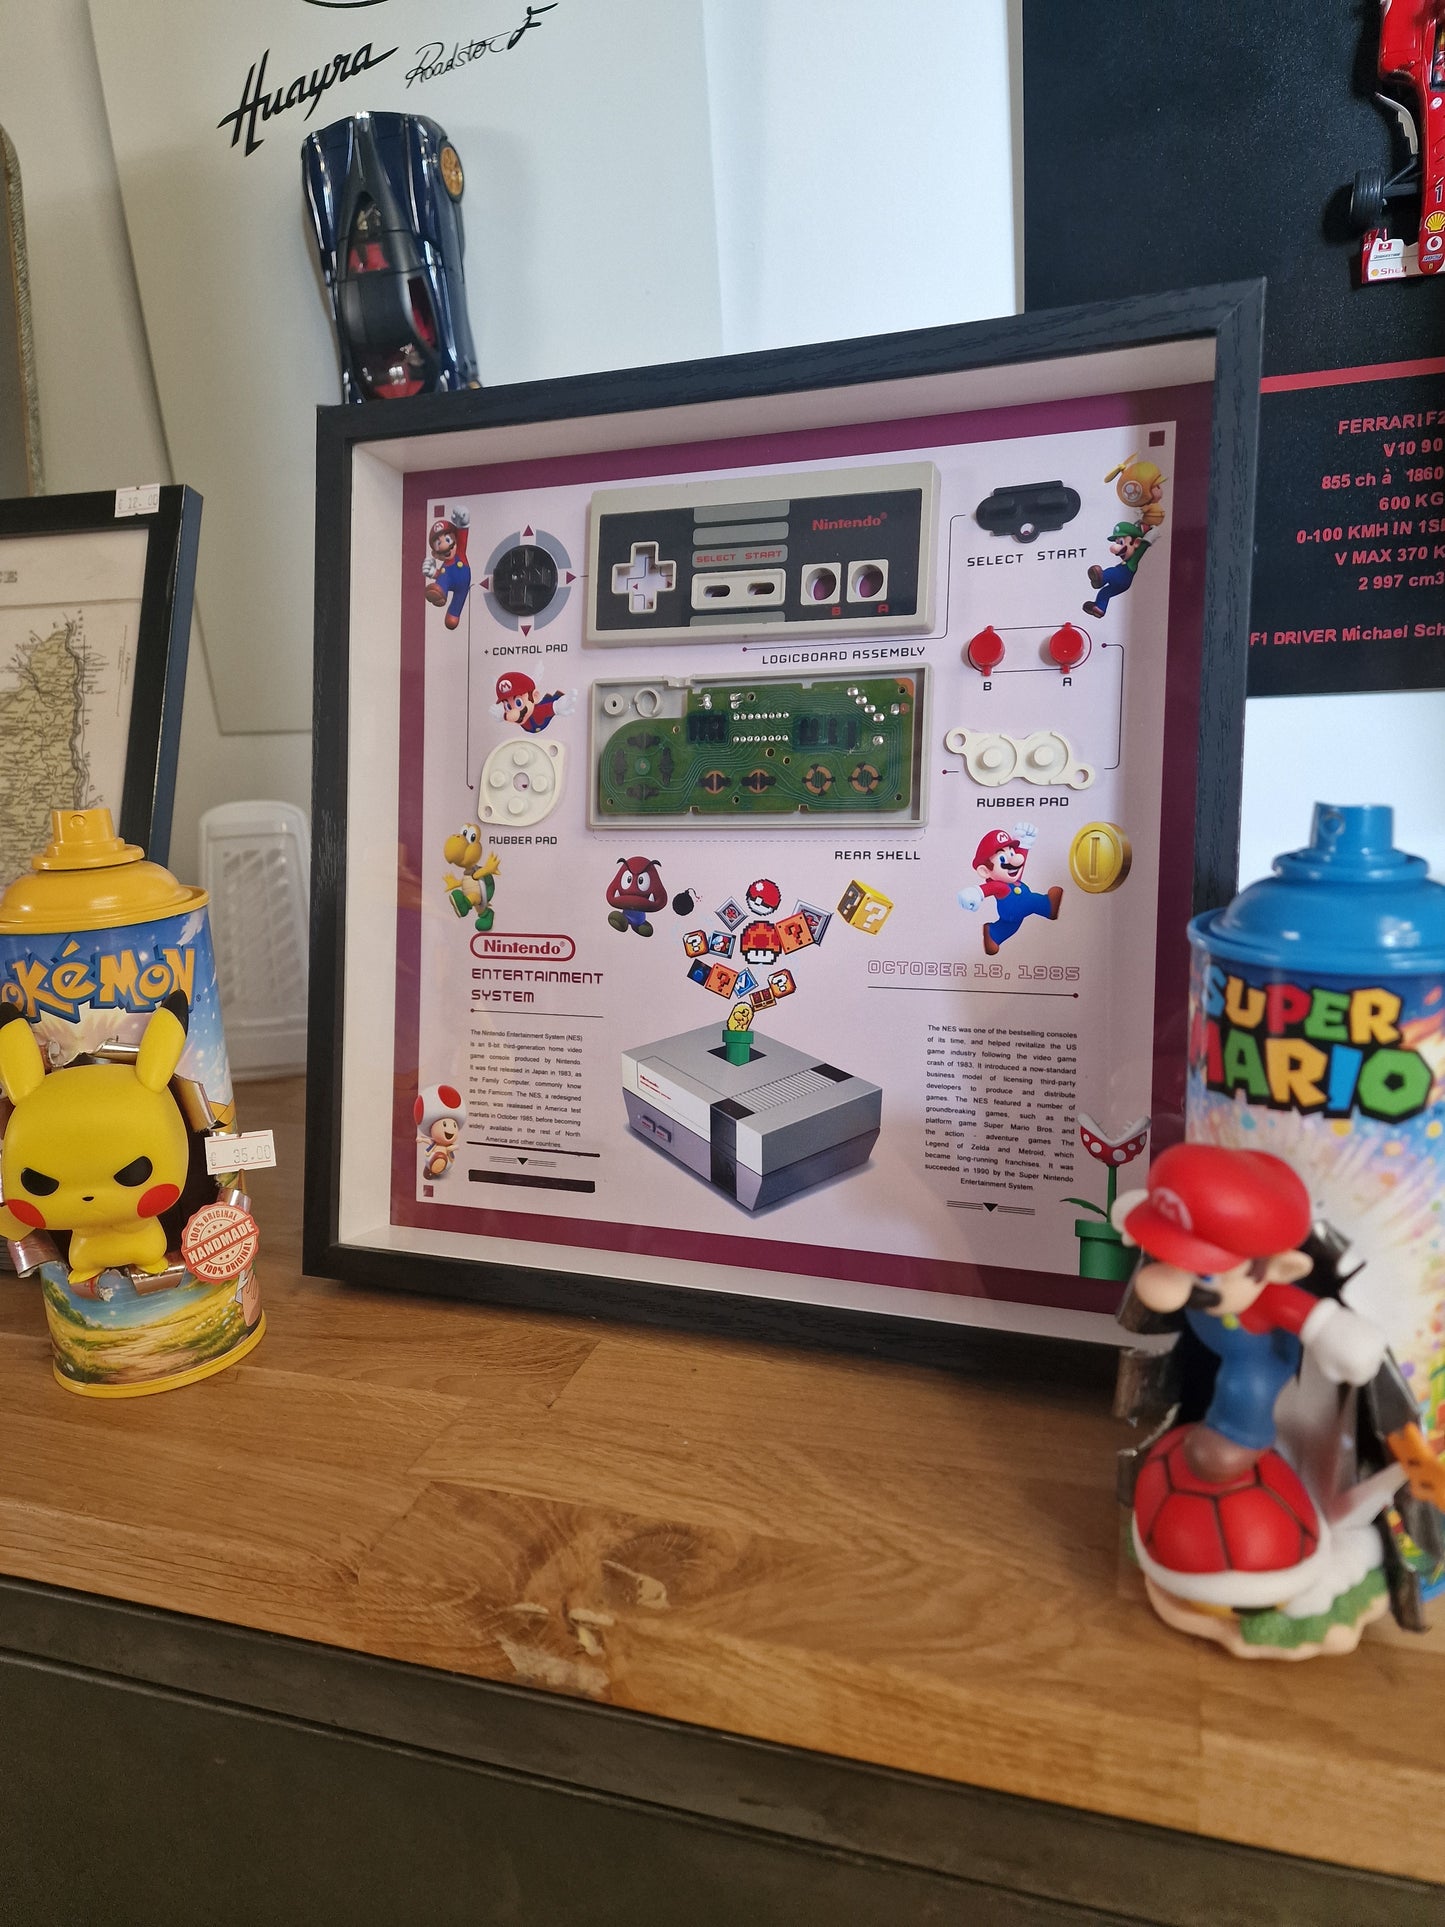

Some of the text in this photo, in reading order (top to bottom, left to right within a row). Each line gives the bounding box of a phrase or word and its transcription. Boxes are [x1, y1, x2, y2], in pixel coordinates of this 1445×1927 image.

[1338, 413, 1423, 435] FERRARI
[1321, 473, 1351, 490] 855
[1355, 473, 1376, 488] ch
[1406, 466, 1444, 482] 1860
[1379, 491, 1444, 511] 600 KG
[1296, 527, 1342, 544] 0-100
[1348, 523, 1388, 540] KMH
[1393, 520, 1413, 535] IN
[696, 550, 783, 563] SELECT START
[967, 548, 1087, 567] SELECT START
[1335, 552, 1347, 566] V
[1352, 549, 1392, 565] MAX
[1397, 546, 1428, 561] 370
[1358, 577, 1368, 591] 2
[1373, 574, 1404, 589] 997
[831, 604, 889, 616] B A
[1250, 632, 1268, 646] F1
[1273, 629, 1337, 645] DRIVER
[1342, 625, 1408, 641] Michael
[492, 645, 543, 656] CONTROL
[545, 643, 568, 653] PAD
[762, 646, 926, 665] LOGICBOARD ASSEMBLY
[983, 677, 1072, 691] B A
[976, 796, 1069, 808] RUBBER PAD
[489, 835, 558, 846] RUBBER PAD
[834, 850, 921, 861] REAR SHELL
[471, 968, 604, 984] ENTERTAINMENT
[867, 960, 1080, 981] OCTOBER 18, 1985
[471, 989, 535, 1003] SYSTEM
[1201, 964, 1402, 1045] SUPER
[506, 1031, 543, 1039] Entertainment
[544, 1033, 564, 1041] System
[566, 1034, 582, 1042] (NES)
[1009, 1029, 1044, 1038] bestselling
[503, 1043, 544, 1052] third-generation
[988, 1039, 1010, 1048] helped
[514, 1055, 539, 1063] produced
[950, 1049, 975, 1057] industry
[981, 1051, 1010, 1059] following
[531, 1068, 547, 1076] Japan
[1030, 1066, 1076, 1074] now-standard
[1003, 1076, 1032, 1084] licensing
[1040, 1078, 1075, 1087] third-party
[926, 1083, 961, 1092] developers
[986, 1087, 1012, 1095] produce
[993, 1098, 1020, 1106] featured
[925, 1106, 975, 1116] groundbreaking
[233, 1144, 272, 1164] 35.00
[960, 1178, 1033, 1191] Entertainment System
[189, 1209, 238, 1242] 100% ORIGINAL
[187, 1219, 255, 1265] HANDMADE
[203, 1241, 252, 1276] 100% ORIGINAL
